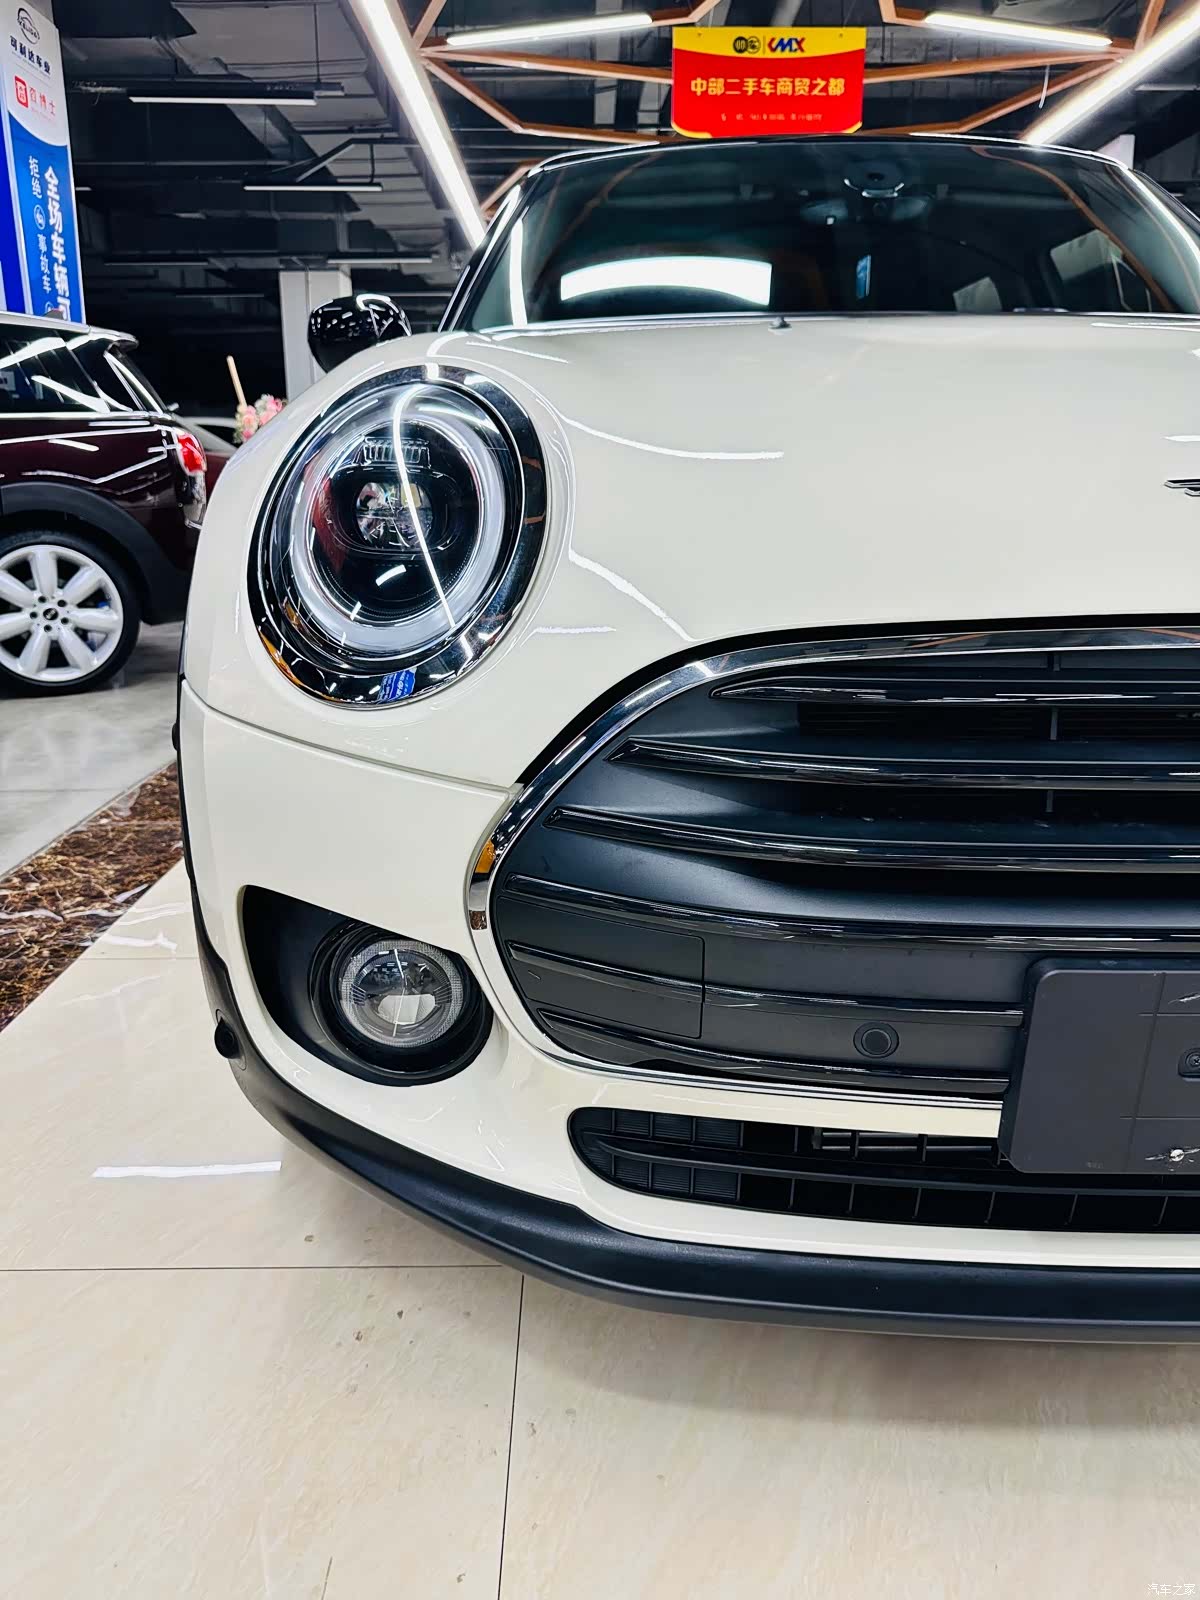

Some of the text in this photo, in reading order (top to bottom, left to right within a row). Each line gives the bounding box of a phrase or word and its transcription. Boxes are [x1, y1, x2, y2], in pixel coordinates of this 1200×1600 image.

[690, 77, 846, 97] 中部二手车商贸之都
